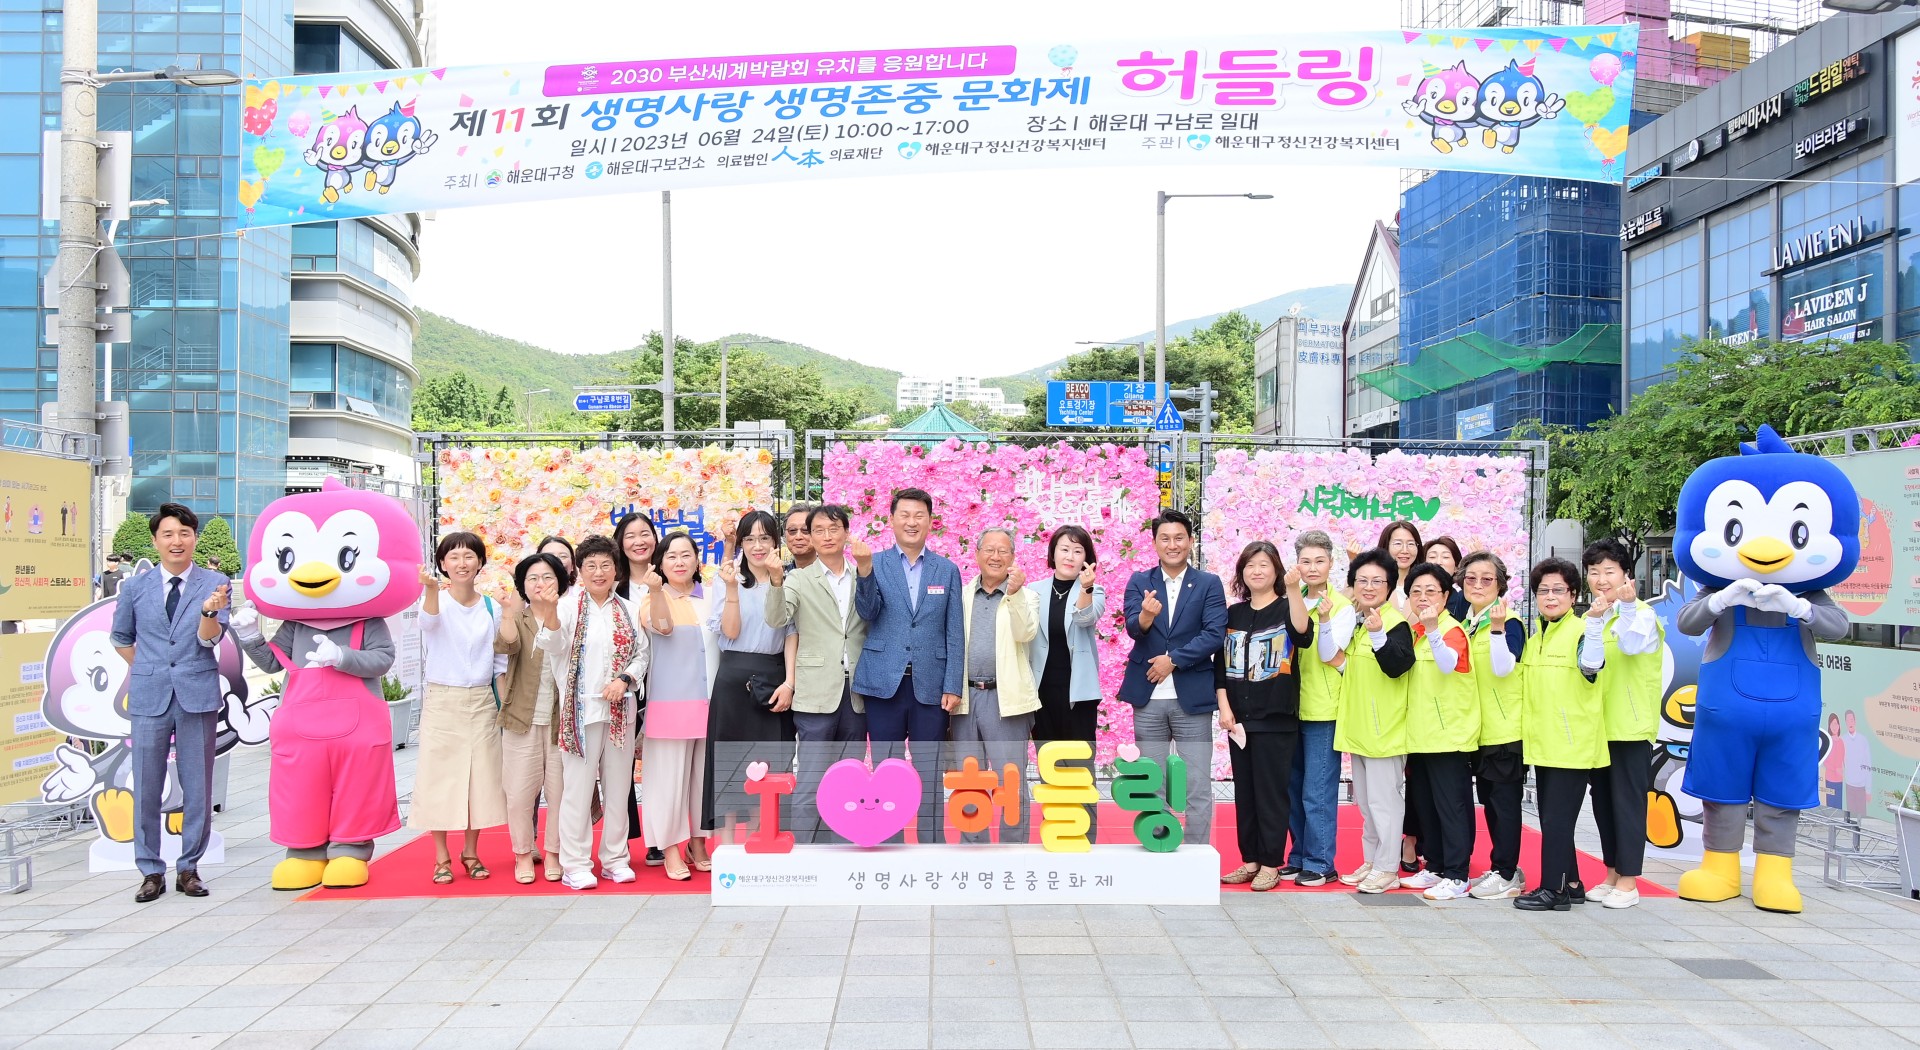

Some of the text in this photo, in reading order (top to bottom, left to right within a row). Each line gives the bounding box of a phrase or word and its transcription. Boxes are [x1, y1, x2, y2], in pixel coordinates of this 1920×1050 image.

[611, 52, 988, 85] 2030 부산세계박람회 유치를 응원합니다
[1116, 46, 1374, 106] 허들링
[1810, 59, 1843, 96] 드림힐
[581, 90, 754, 131] 생명사랑
[764, 82, 943, 120] 생명존중
[953, 76, 1091, 112] 문화제
[1748, 93, 1782, 129] 마사지
[570, 137, 606, 157] 일시
[621, 131, 688, 152] 2023년
[698, 128, 741, 147] 06월
[752, 124, 829, 144] 24일(토)
[1027, 115, 1067, 133] 장소
[1089, 114, 1148, 132] 해운대
[1154, 113, 1213, 131] 구남로
[1220, 112, 1259, 130] 일대
[829, 136, 1400, 162] 의료재단 해운대구정신건강복지센터 주관 해운대구정신건강복지센터
[1795, 119, 1846, 160] 보이브라질
[444, 153, 768, 190] 주최 해운대구청 해운대구보건소 의료법인
[1773, 215, 1863, 271] LA VIE EN J
[1794, 283, 1867, 320] LAVIEEN J
[1804, 309, 1857, 333] HAIR SALON
[1713, 331, 1750, 347] AVIEEN
[1059, 400, 1095, 410] 요트경기장
[1066, 383, 1089, 393] BEXCO
[1124, 383, 1145, 394] 기장
[15, 565, 36, 575] 청년들의
[50, 577, 71, 586] 스트레스
[1826, 653, 1852, 671] 어려움
[943, 740, 1187, 853] 허들링
